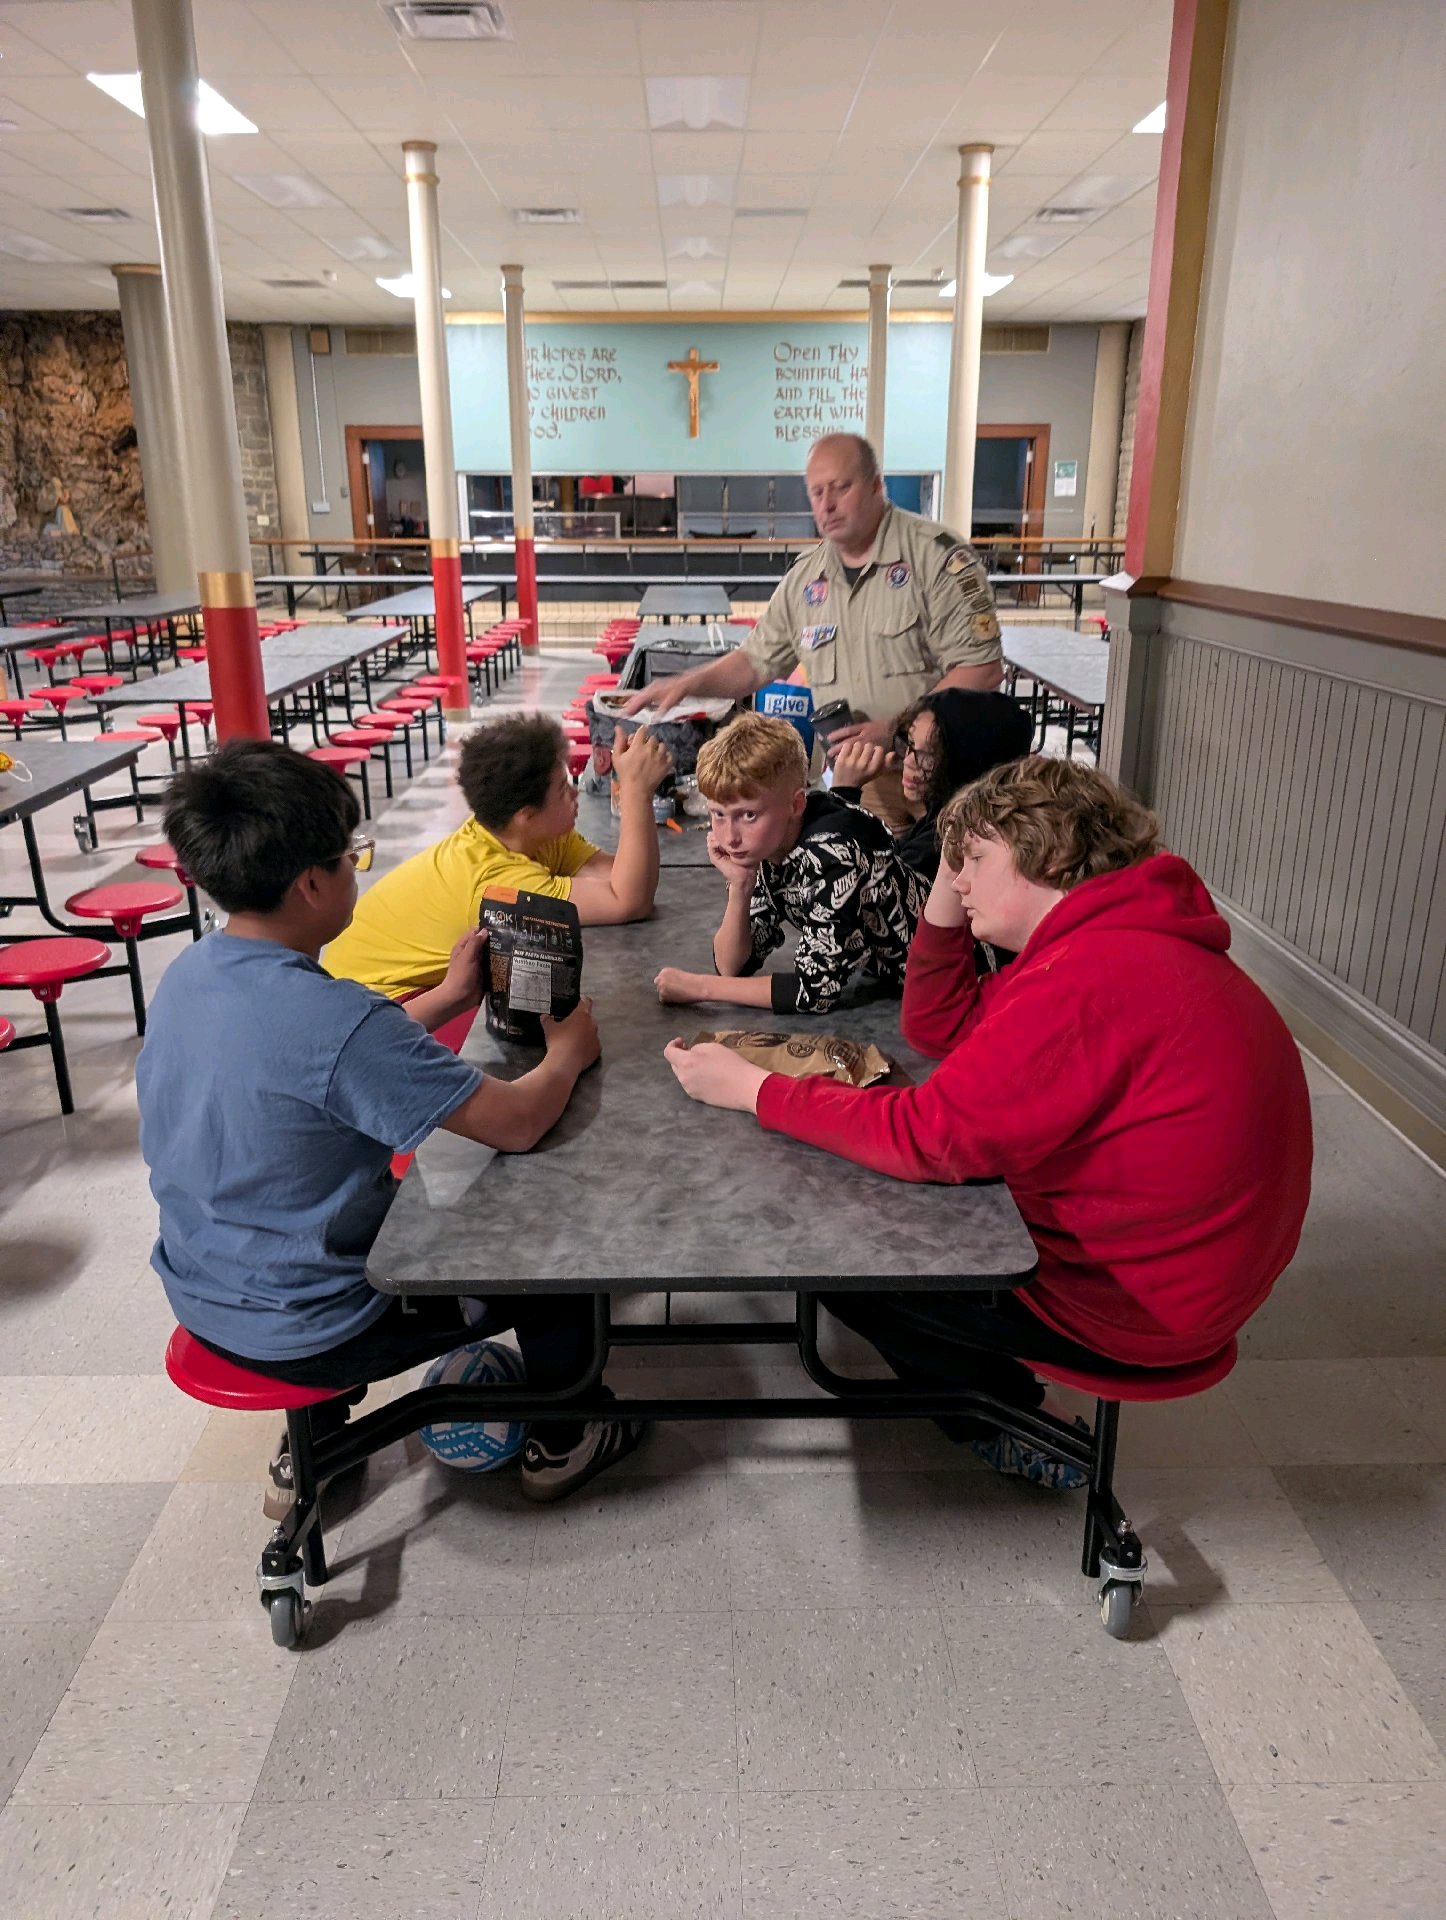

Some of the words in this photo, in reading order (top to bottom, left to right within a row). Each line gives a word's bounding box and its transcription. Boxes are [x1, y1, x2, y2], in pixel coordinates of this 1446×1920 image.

[592, 347, 617, 362] ARE
[775, 365, 843, 383] BOUNTIFUL
[546, 385, 598, 400] GIVEST
[775, 386, 802, 401] AND
[808, 386, 835, 403] FILL
[541, 403, 606, 422] CHILDREN
[774, 403, 822, 421] EARTH
[829, 403, 864, 421] WITH
